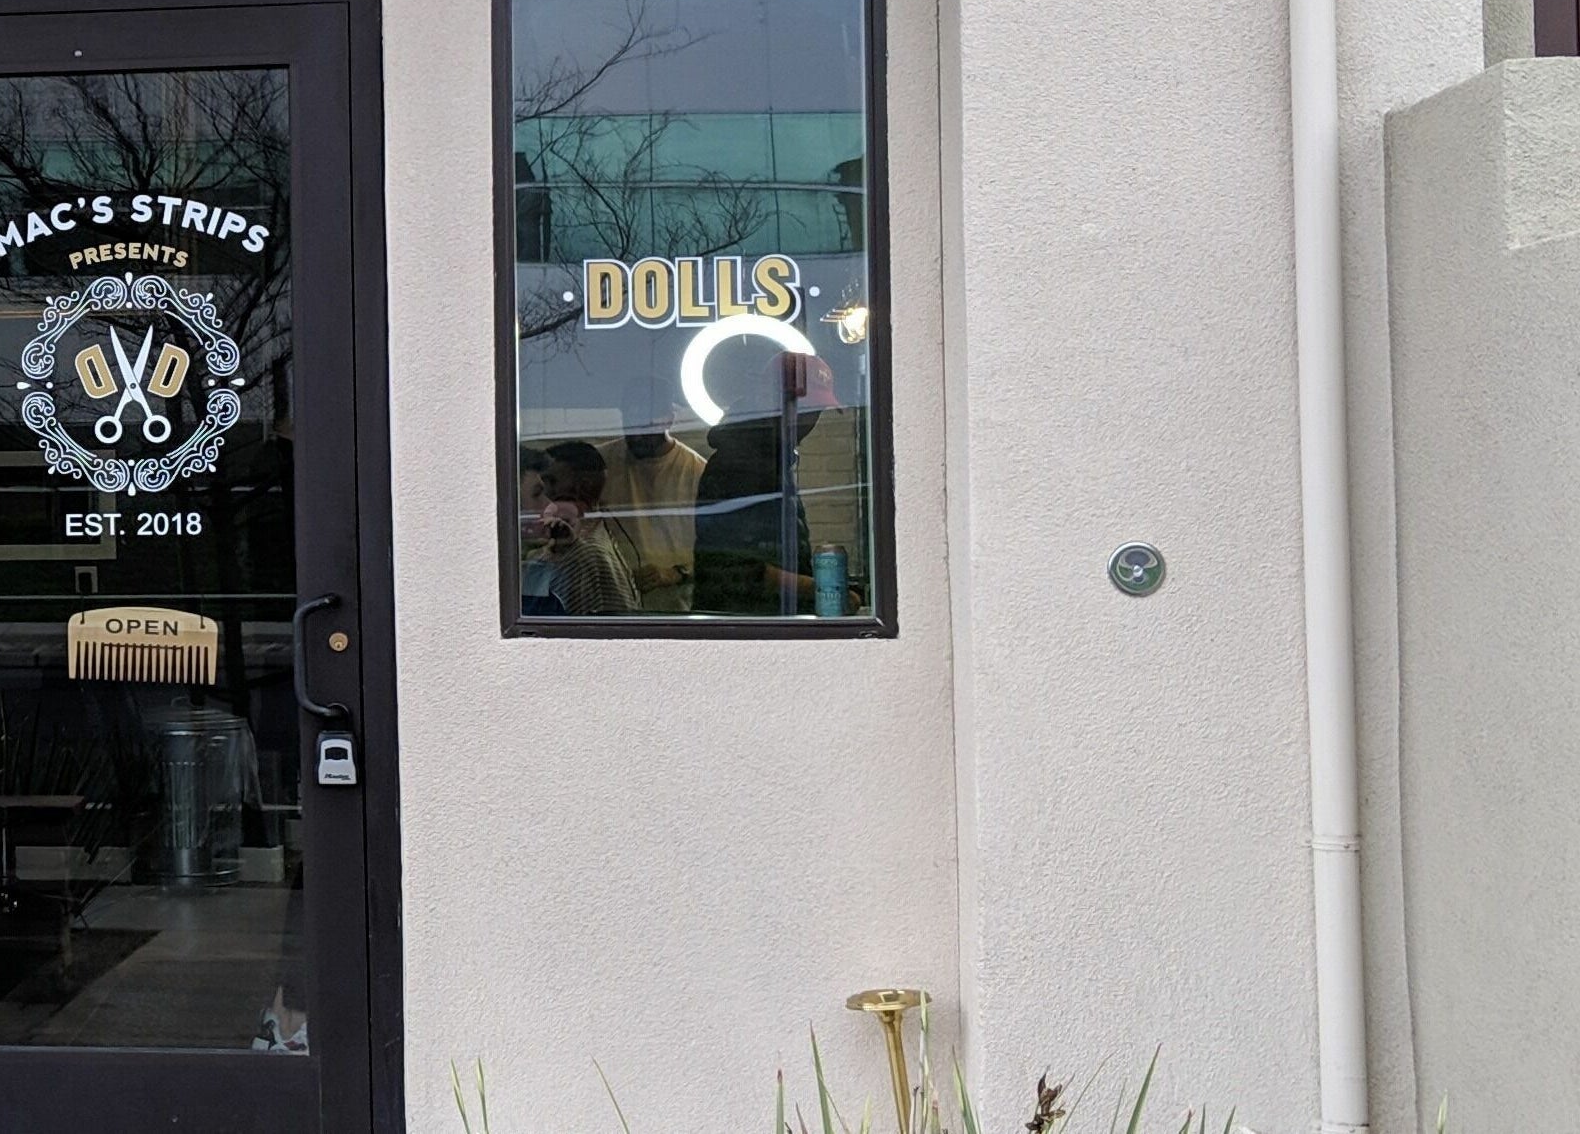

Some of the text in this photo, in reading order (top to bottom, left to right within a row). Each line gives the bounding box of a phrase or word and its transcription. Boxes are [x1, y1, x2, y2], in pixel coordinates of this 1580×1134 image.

[130, 194, 270, 253] STRIPS
[68, 242, 189, 270] PRESENTS
[583, 254, 802, 329] DOLLS
[65, 512, 203, 537] EST. 2018
[105, 618, 179, 636] OPEN
